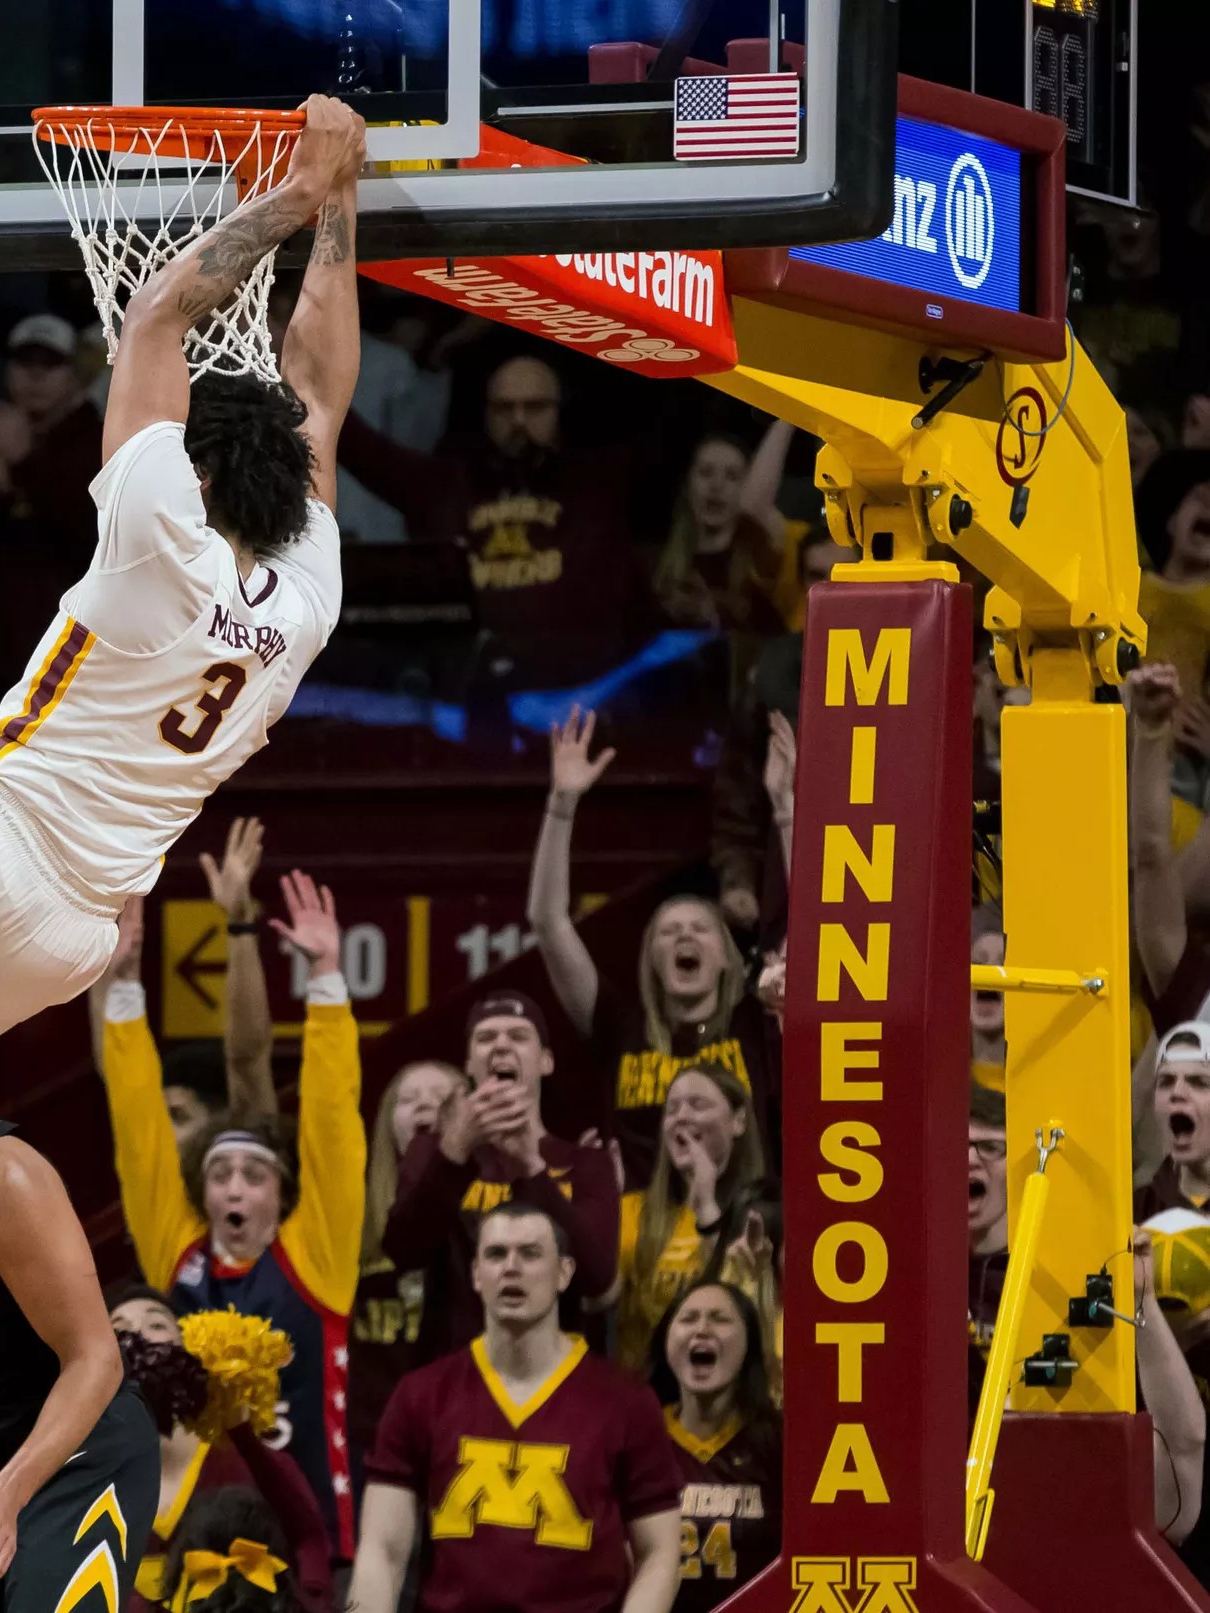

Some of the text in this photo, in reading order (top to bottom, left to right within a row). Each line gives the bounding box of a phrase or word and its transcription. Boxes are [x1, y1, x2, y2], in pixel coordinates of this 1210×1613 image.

[878, 174, 937, 253] nz
[158, 662, 246, 756] 3
[810, 628, 912, 1504] MINNESOTA
[430, 1435, 594, 1551] M
